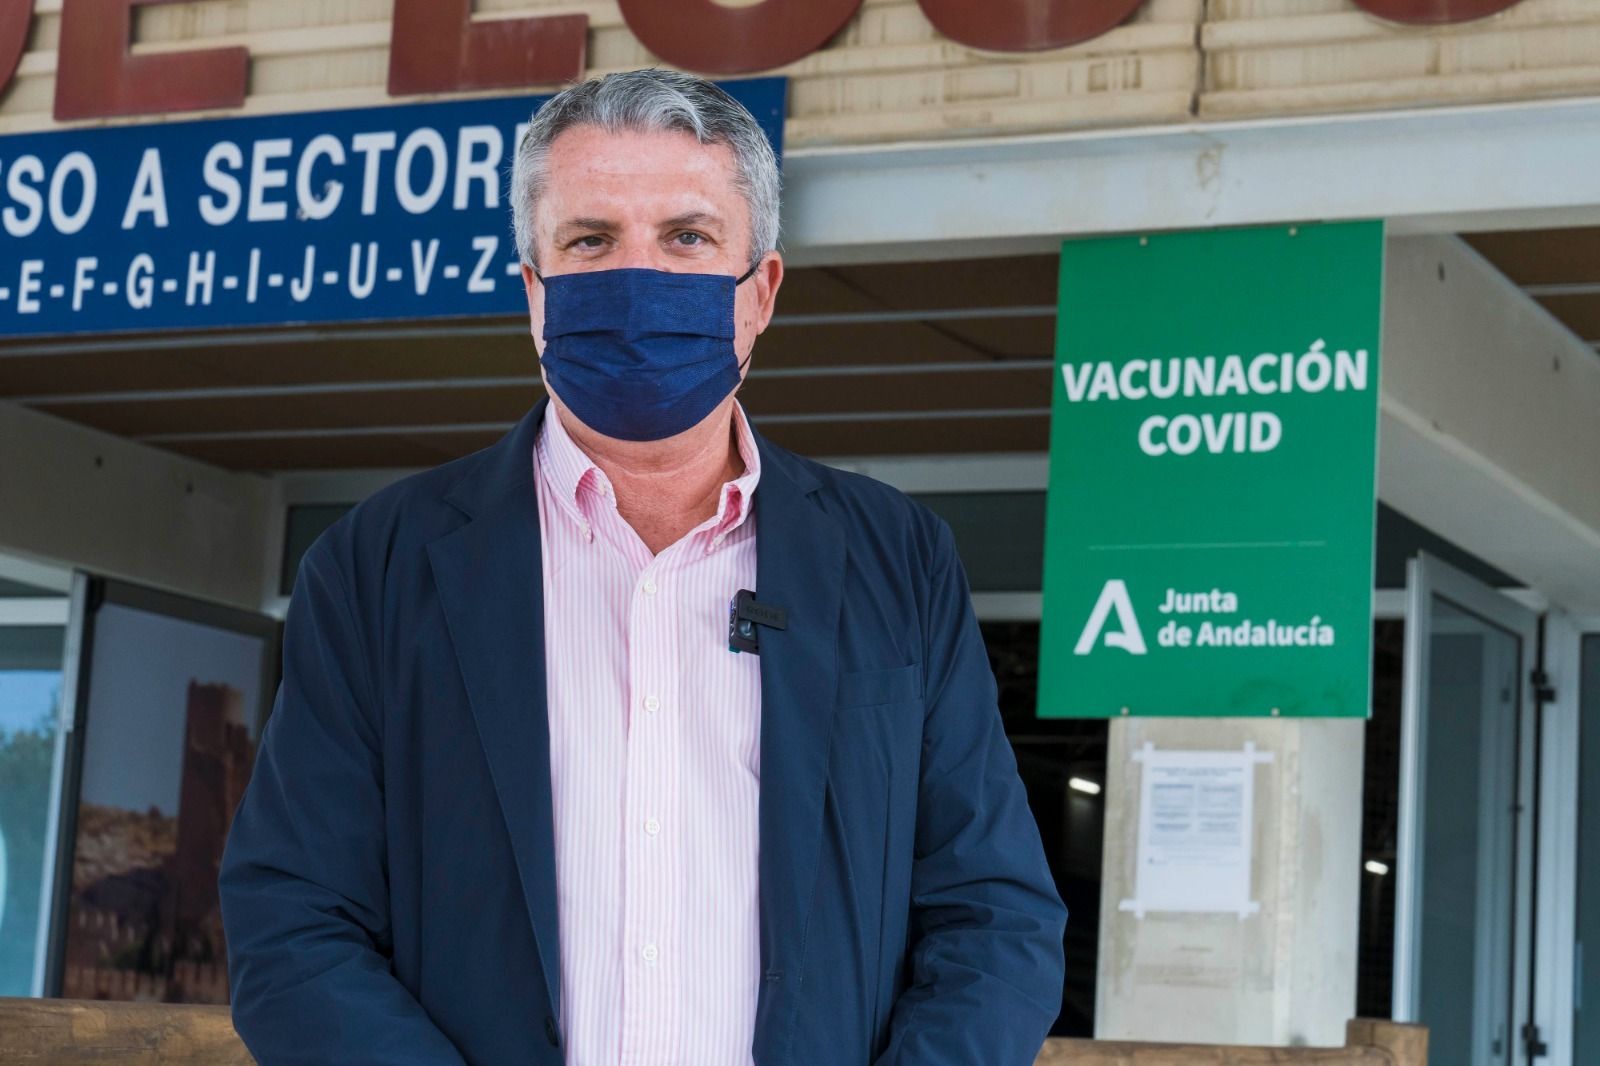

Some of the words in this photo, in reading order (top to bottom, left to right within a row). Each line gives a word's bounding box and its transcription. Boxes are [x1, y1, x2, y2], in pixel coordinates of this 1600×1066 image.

[0, 151, 97, 237] SO
[121, 148, 169, 230] A
[199, 122, 528, 226] SECTOR
[1061, 338, 1368, 402] VACUNACIÓN
[1138, 411, 1282, 456] COVID
[1158, 588, 1238, 613] Junta
[1157, 621, 1192, 647] de
[1196, 615, 1335, 647] Andalucía
